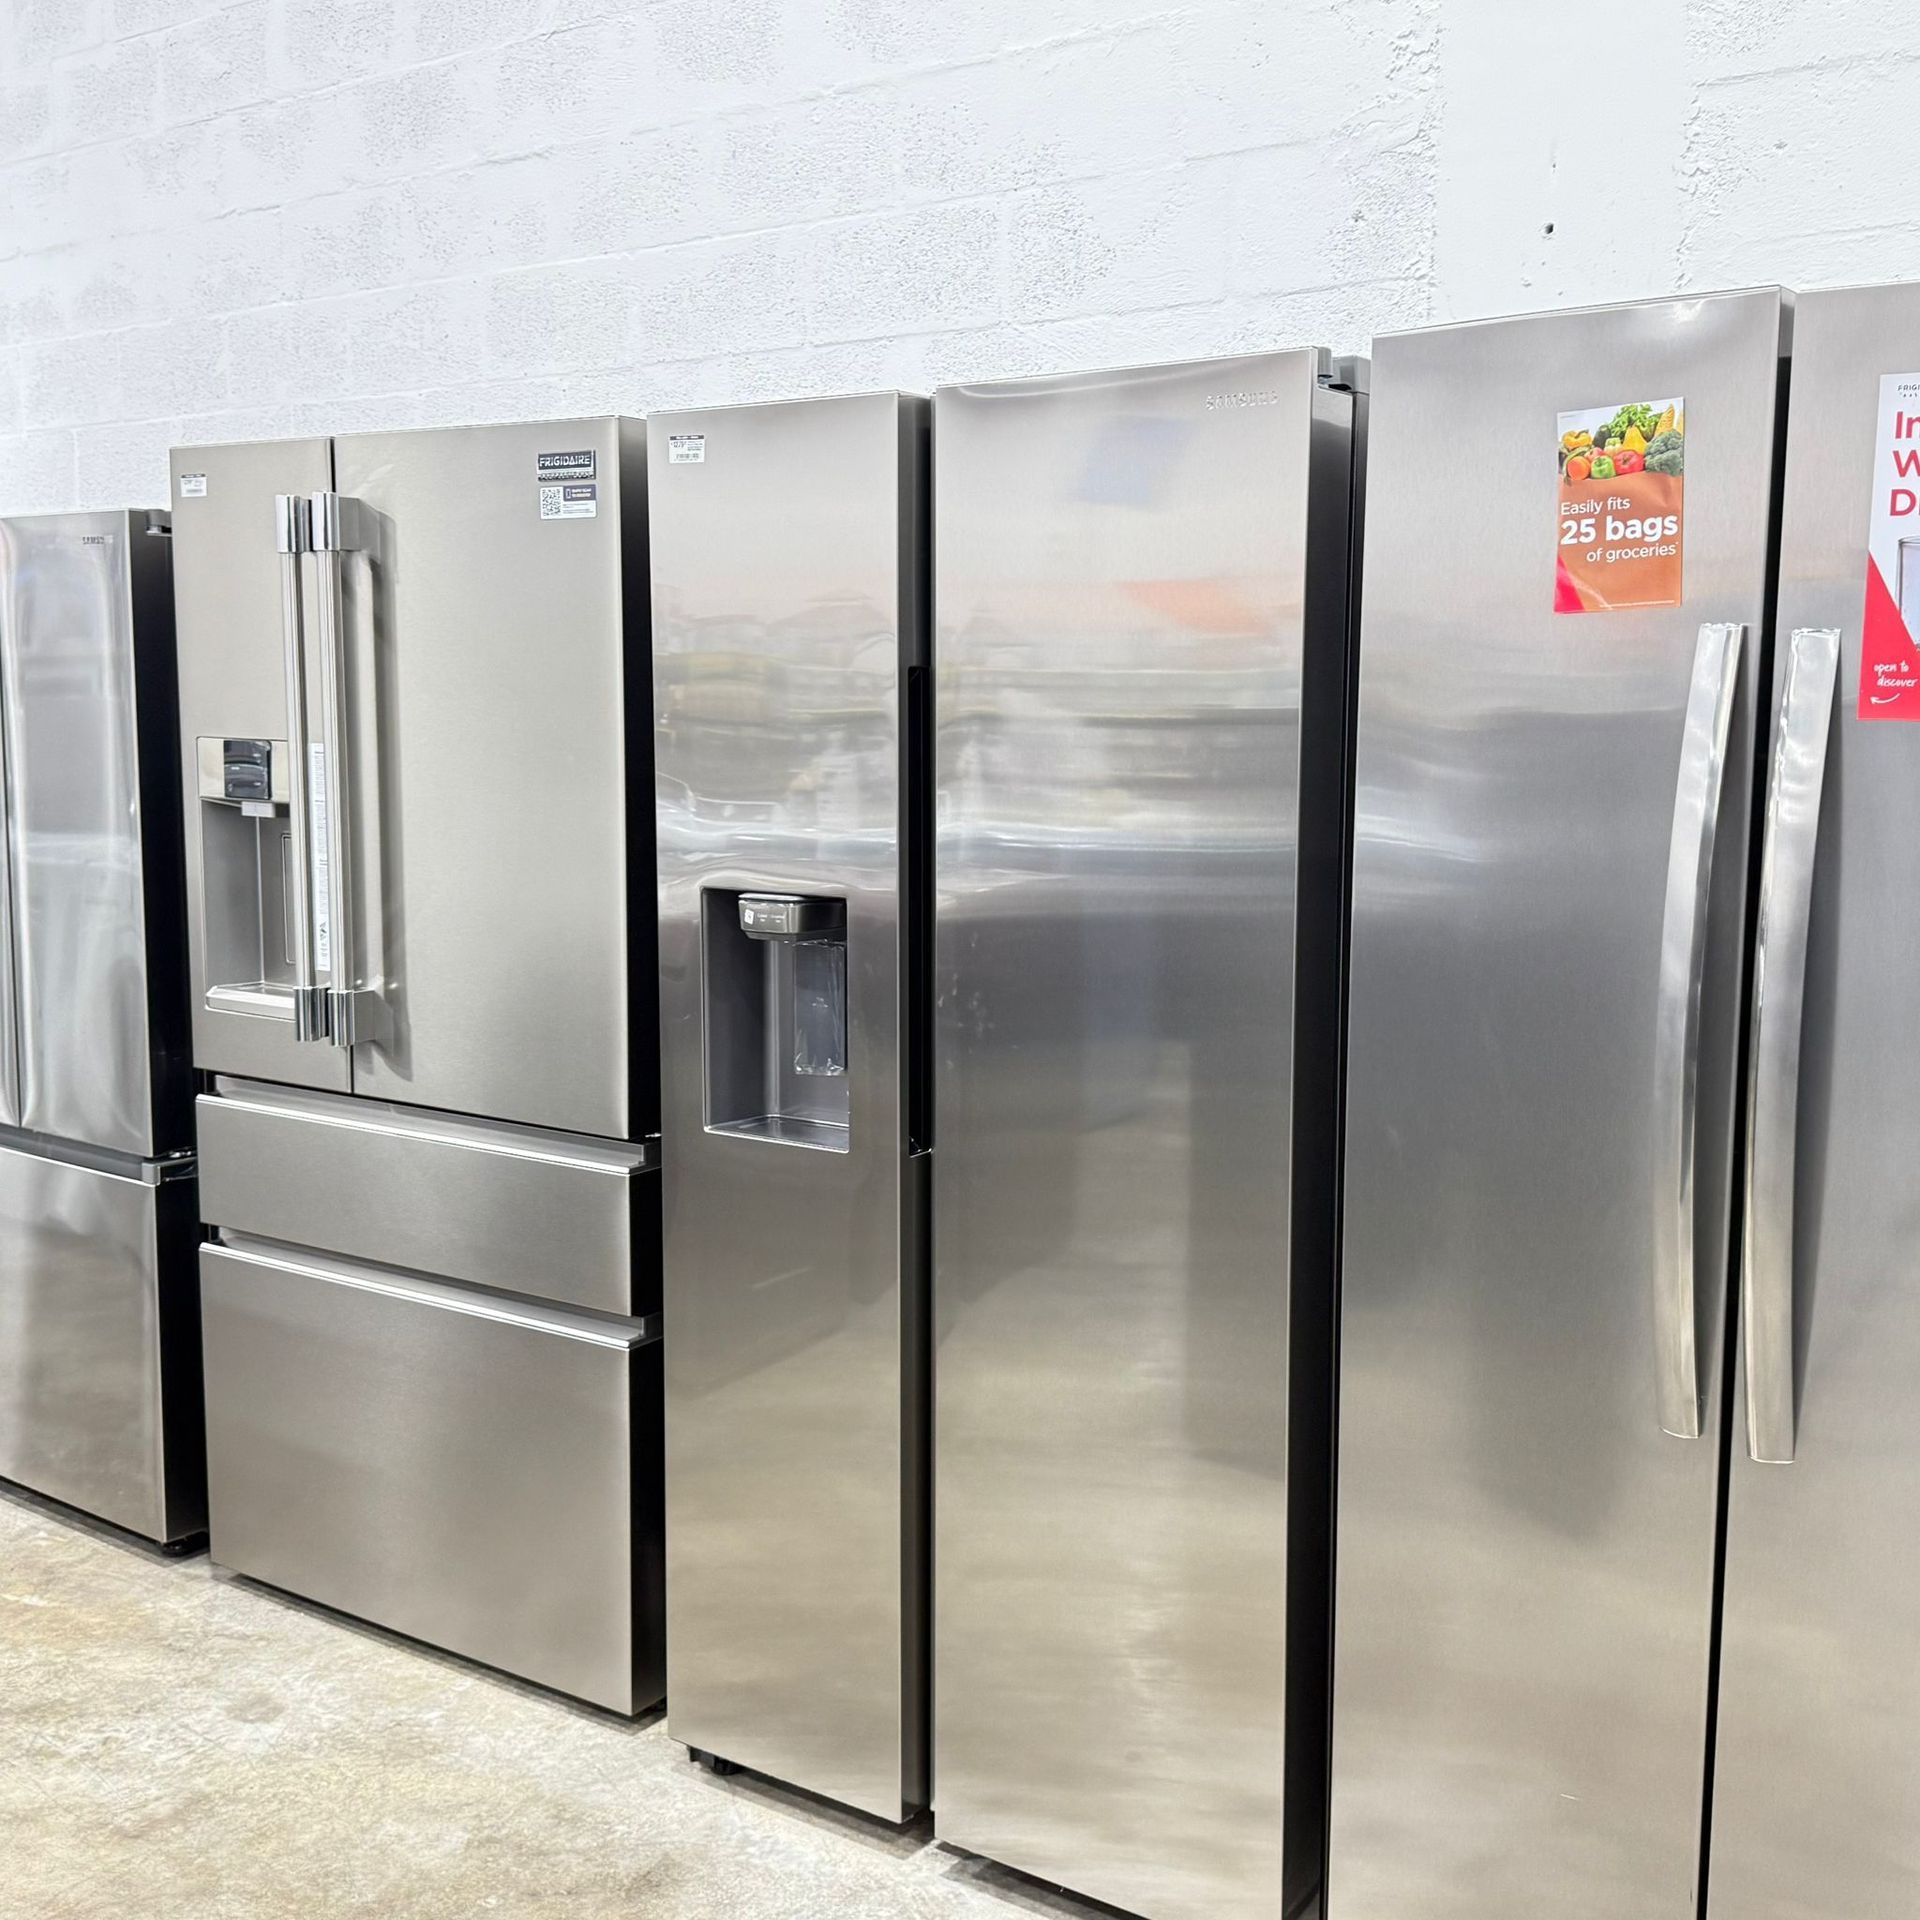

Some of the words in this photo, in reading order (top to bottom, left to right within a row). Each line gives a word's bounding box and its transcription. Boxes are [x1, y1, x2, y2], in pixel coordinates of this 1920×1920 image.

[539, 455, 591, 467] FRIGIDAIRE
[1560, 499, 1603, 515] Easily
[1607, 497, 1630, 511] fits
[1889, 489, 1920, 516] D
[1560, 518, 1596, 545] 25
[1605, 515, 1679, 542] bags
[1586, 548, 1603, 562] of
[1873, 663, 1897, 678] open
[1899, 660, 1910, 673] to
[1877, 674, 1918, 688] discover
